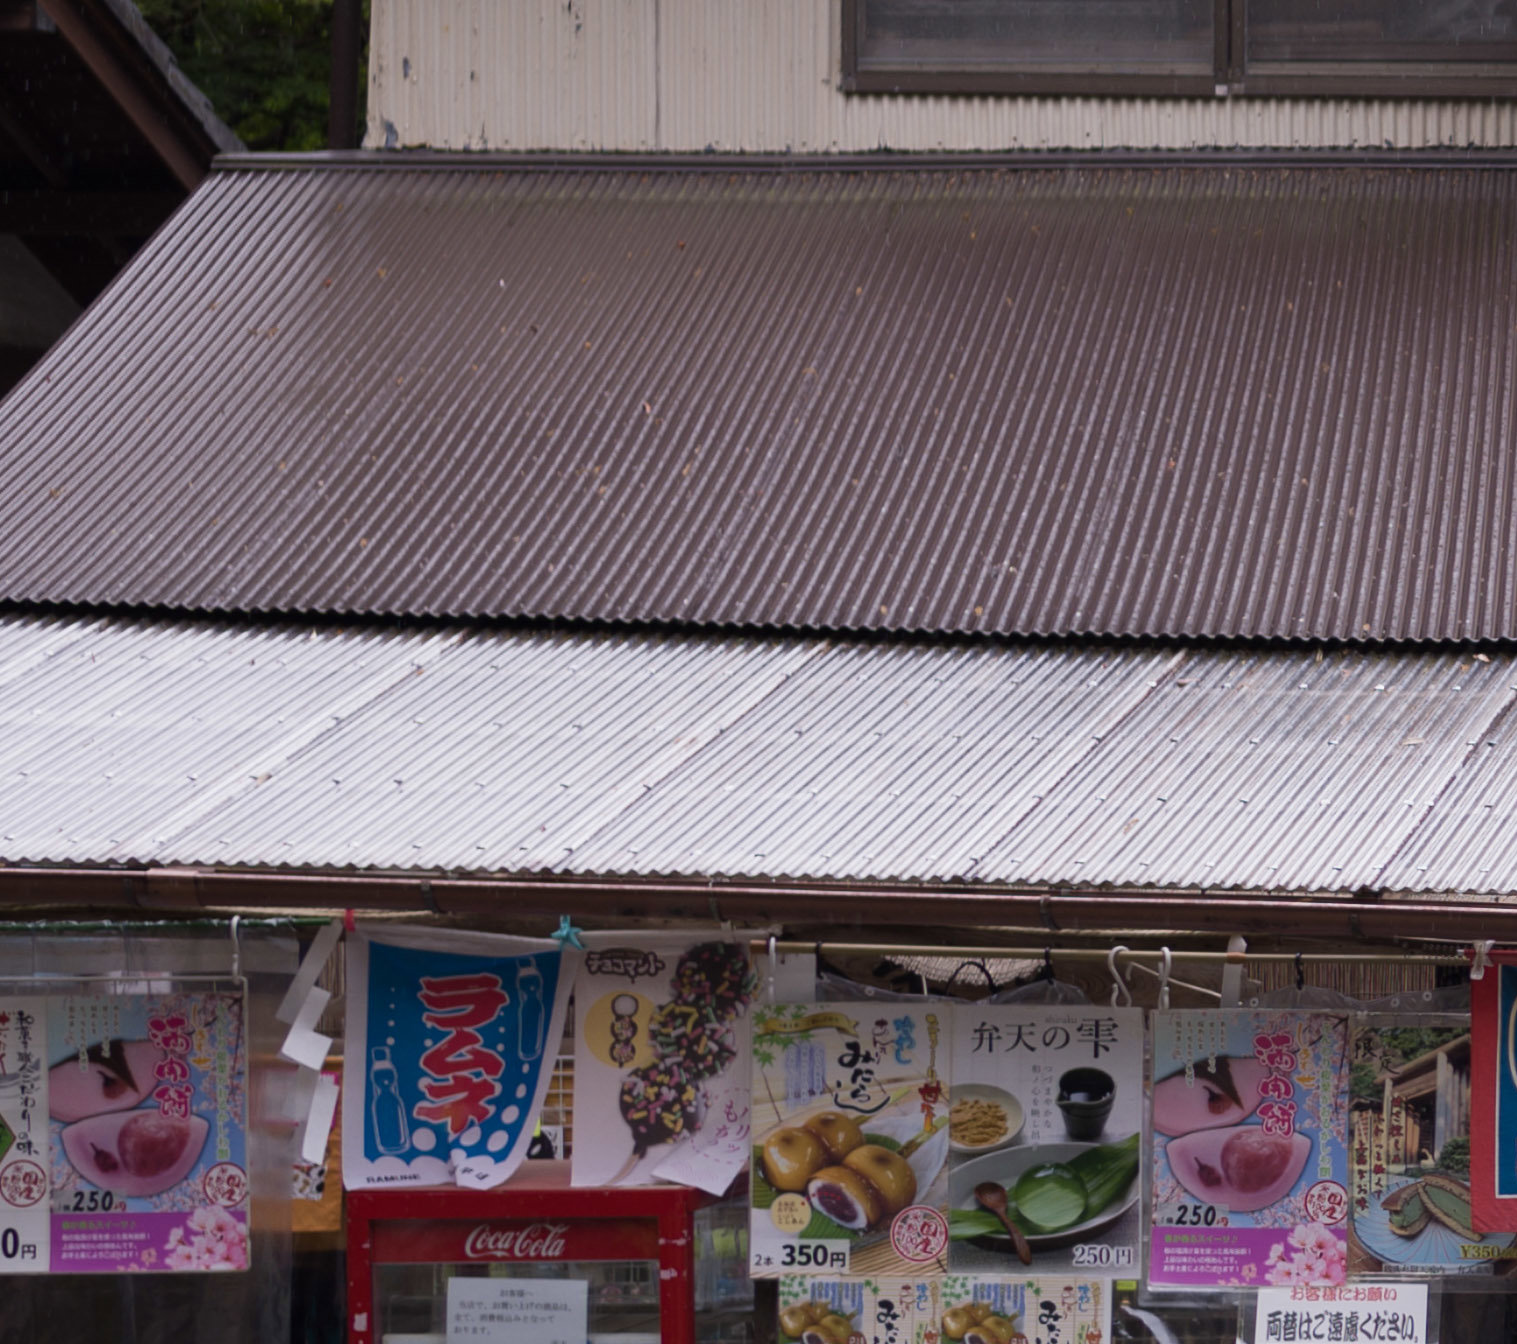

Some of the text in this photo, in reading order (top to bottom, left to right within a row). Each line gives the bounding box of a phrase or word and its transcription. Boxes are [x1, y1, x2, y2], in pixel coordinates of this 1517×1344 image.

[971, 1017, 1119, 1058] 弁天の雫
[414, 973, 510, 1142] ラムネ
[464, 1223, 570, 1258] Coca-Cola
[755, 1244, 847, 1269] 2本 350円
[1072, 1245, 1133, 1267] 250円
[1290, 1287, 1397, 1302] お客様にお願い
[1266, 1311, 1419, 1343] 両替はご遠慮ください。
